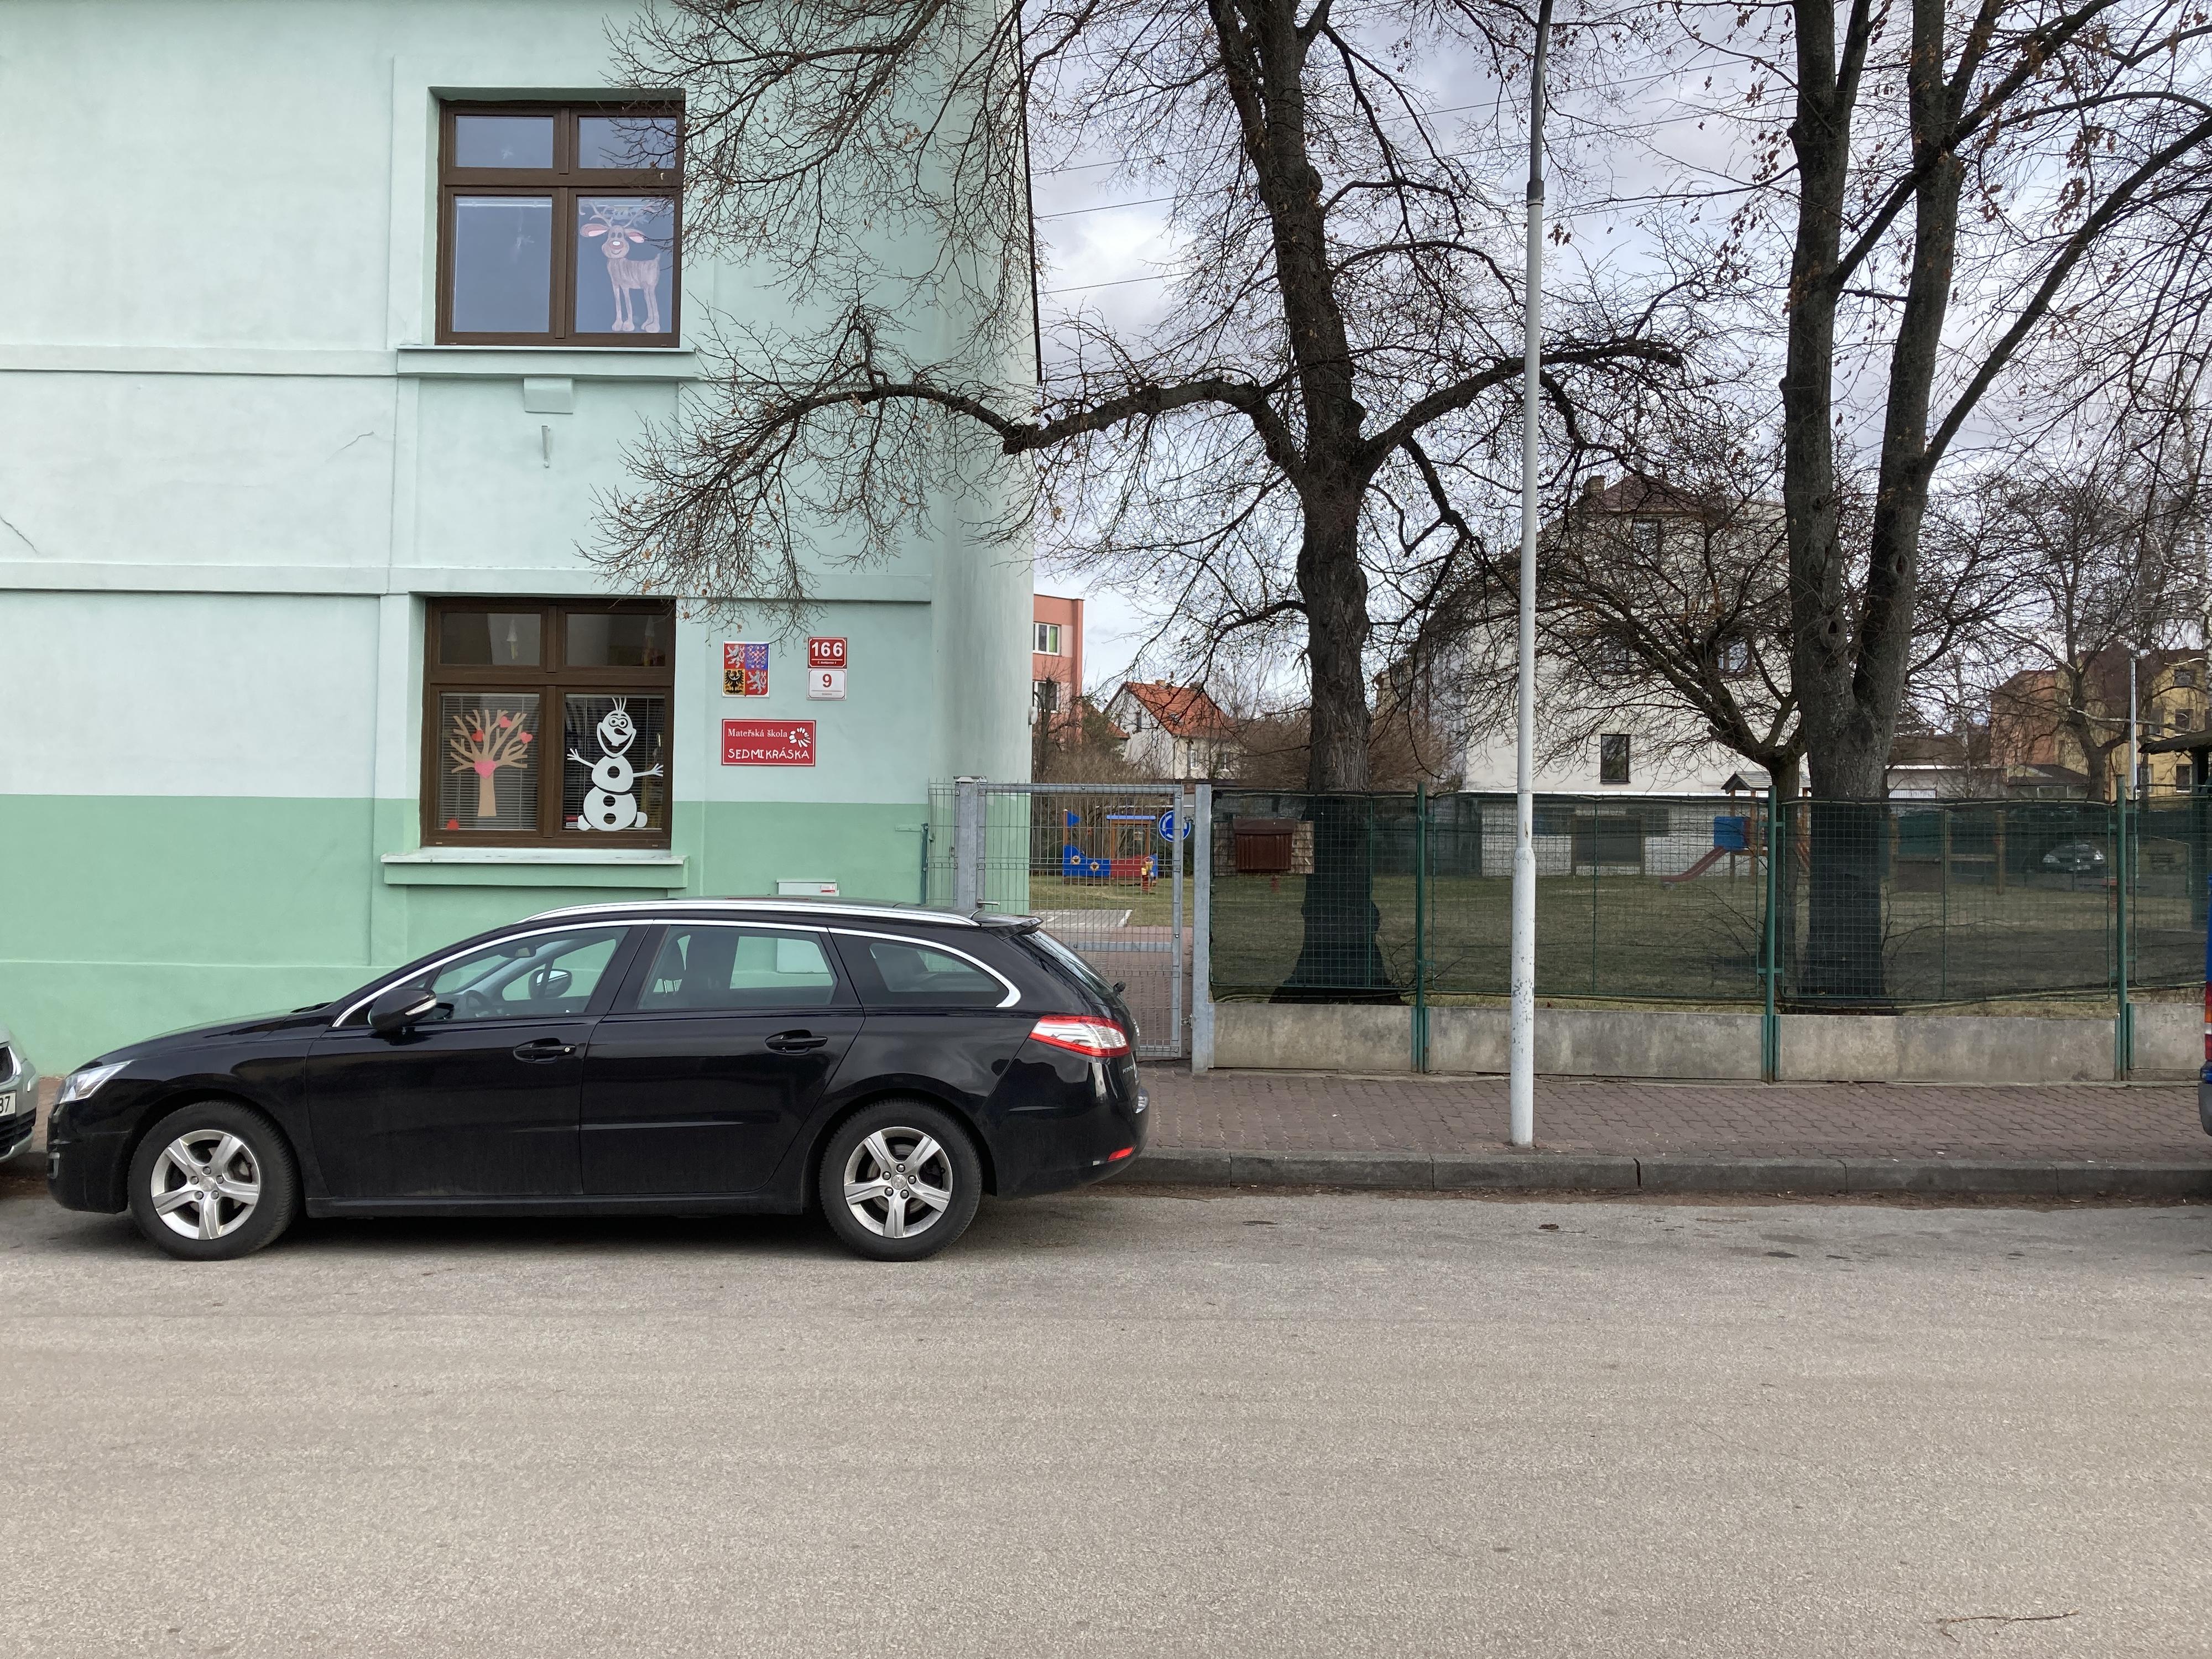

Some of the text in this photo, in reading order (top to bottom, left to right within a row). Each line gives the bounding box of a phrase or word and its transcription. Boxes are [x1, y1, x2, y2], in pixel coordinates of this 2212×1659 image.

[811, 641, 843, 658] 166
[822, 674, 832, 688] 9
[728, 728, 788, 738] Mateřská škola
[728, 747, 810, 760] SEDMIKRÁSKA
